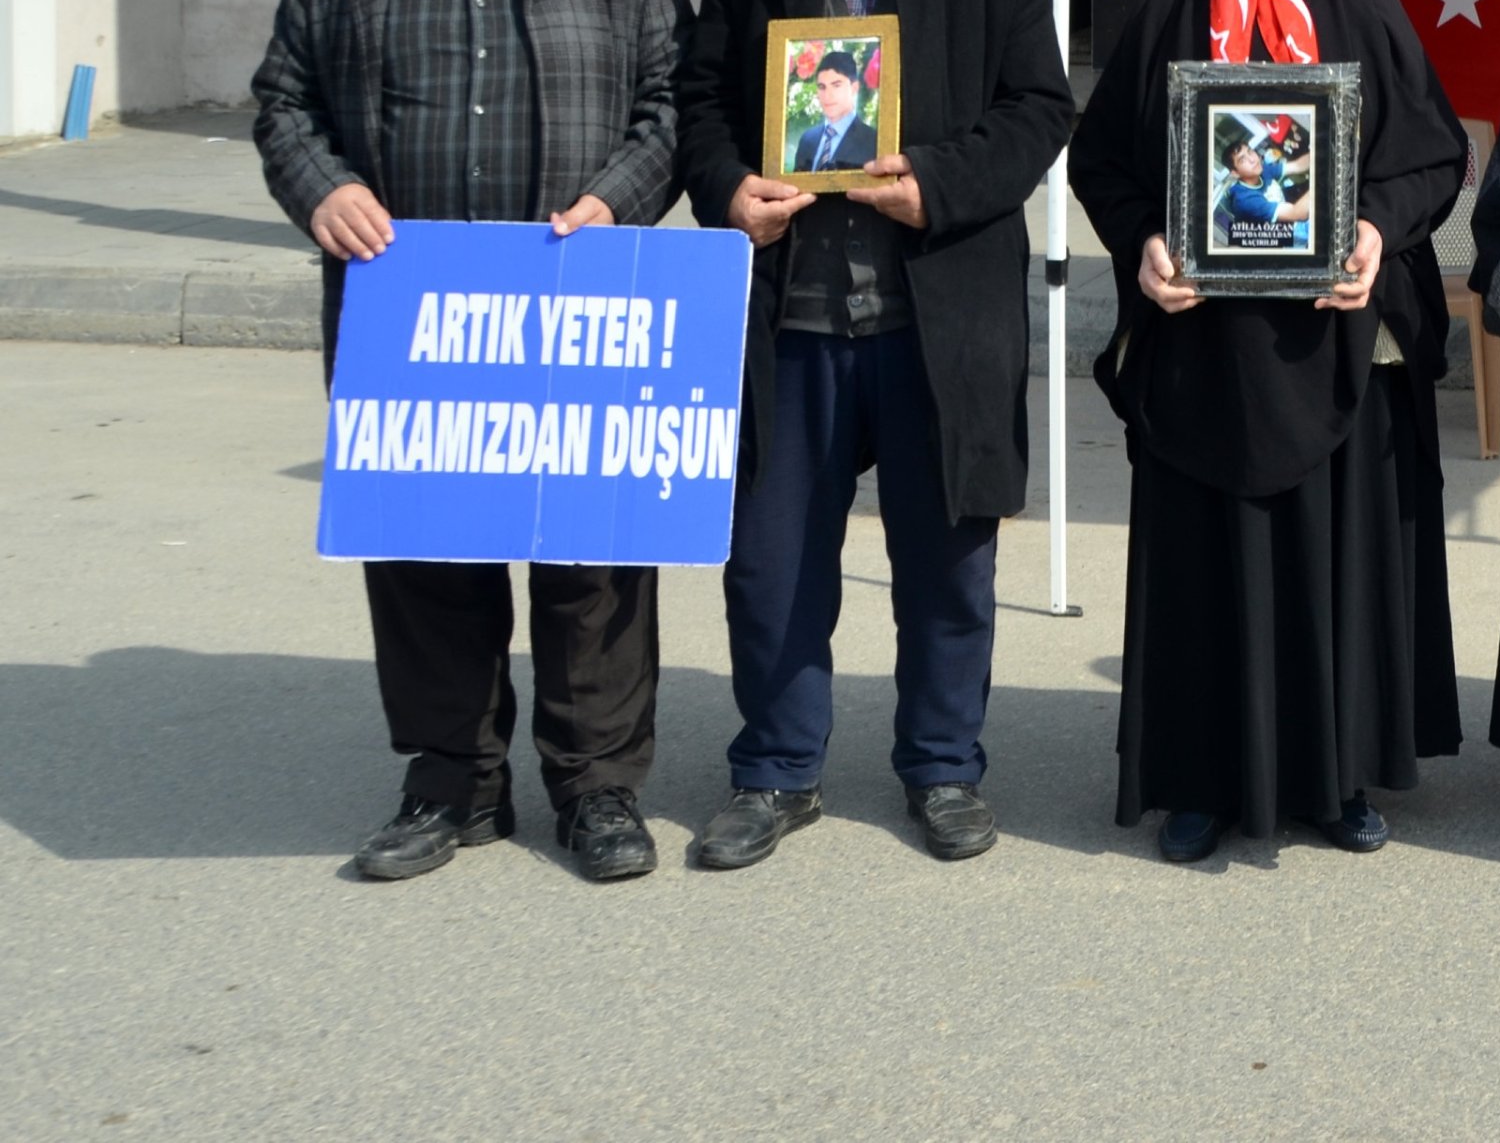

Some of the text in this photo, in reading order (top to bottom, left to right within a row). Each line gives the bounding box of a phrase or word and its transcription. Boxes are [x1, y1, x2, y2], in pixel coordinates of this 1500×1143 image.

[408, 292, 531, 365] ARTIK
[538, 294, 653, 368] YETER
[334, 385, 737, 500] YAKAMIZDAN DÜŞÜN
